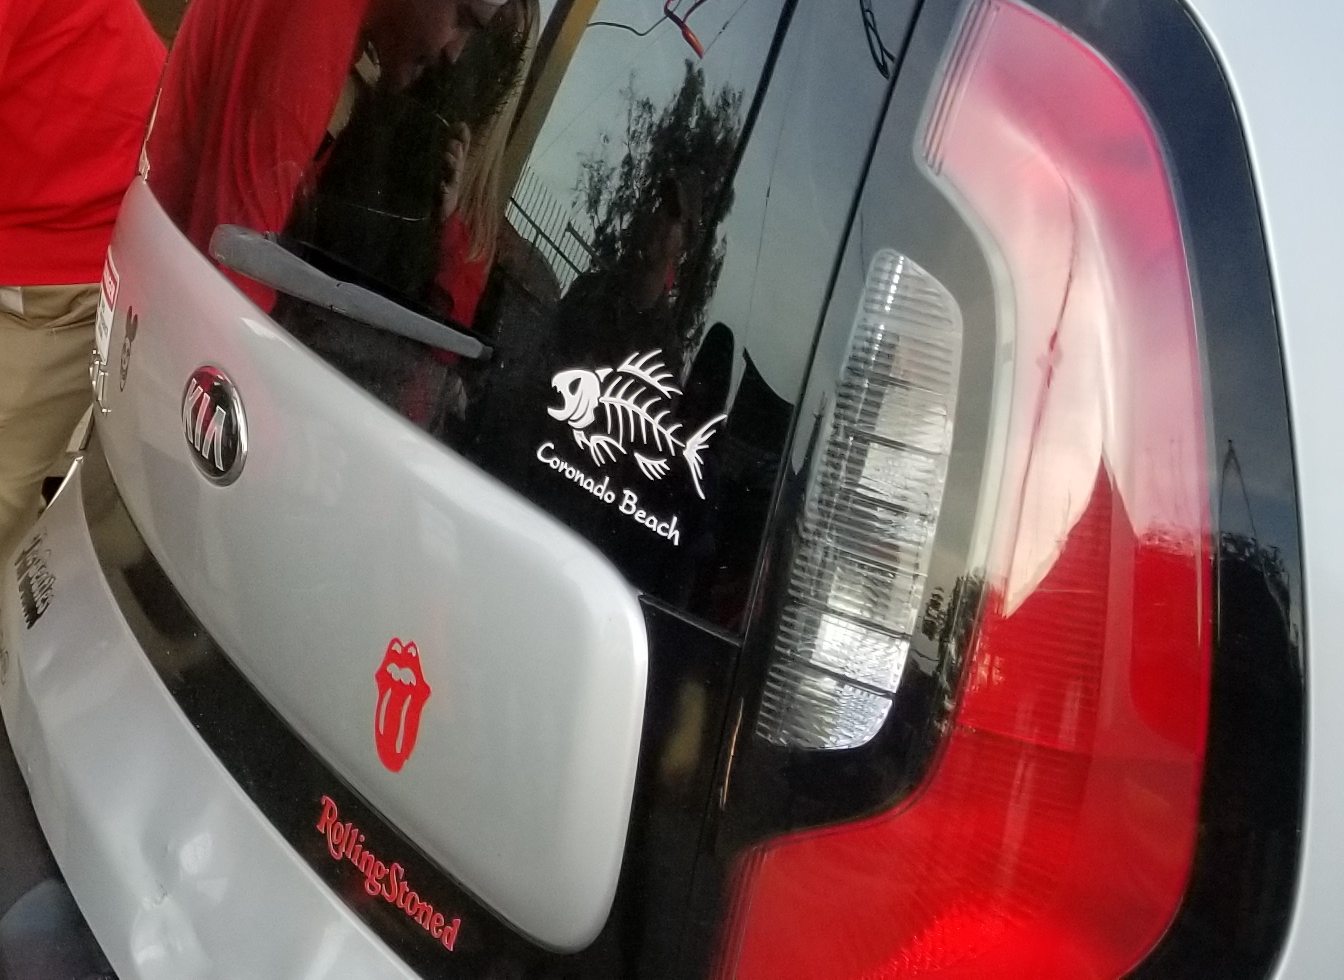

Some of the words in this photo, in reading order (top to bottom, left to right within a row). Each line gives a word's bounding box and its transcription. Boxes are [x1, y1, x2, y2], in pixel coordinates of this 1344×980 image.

[181, 377, 227, 472] KIA
[536, 442, 616, 504] Coronado
[618, 488, 680, 546] Beach
